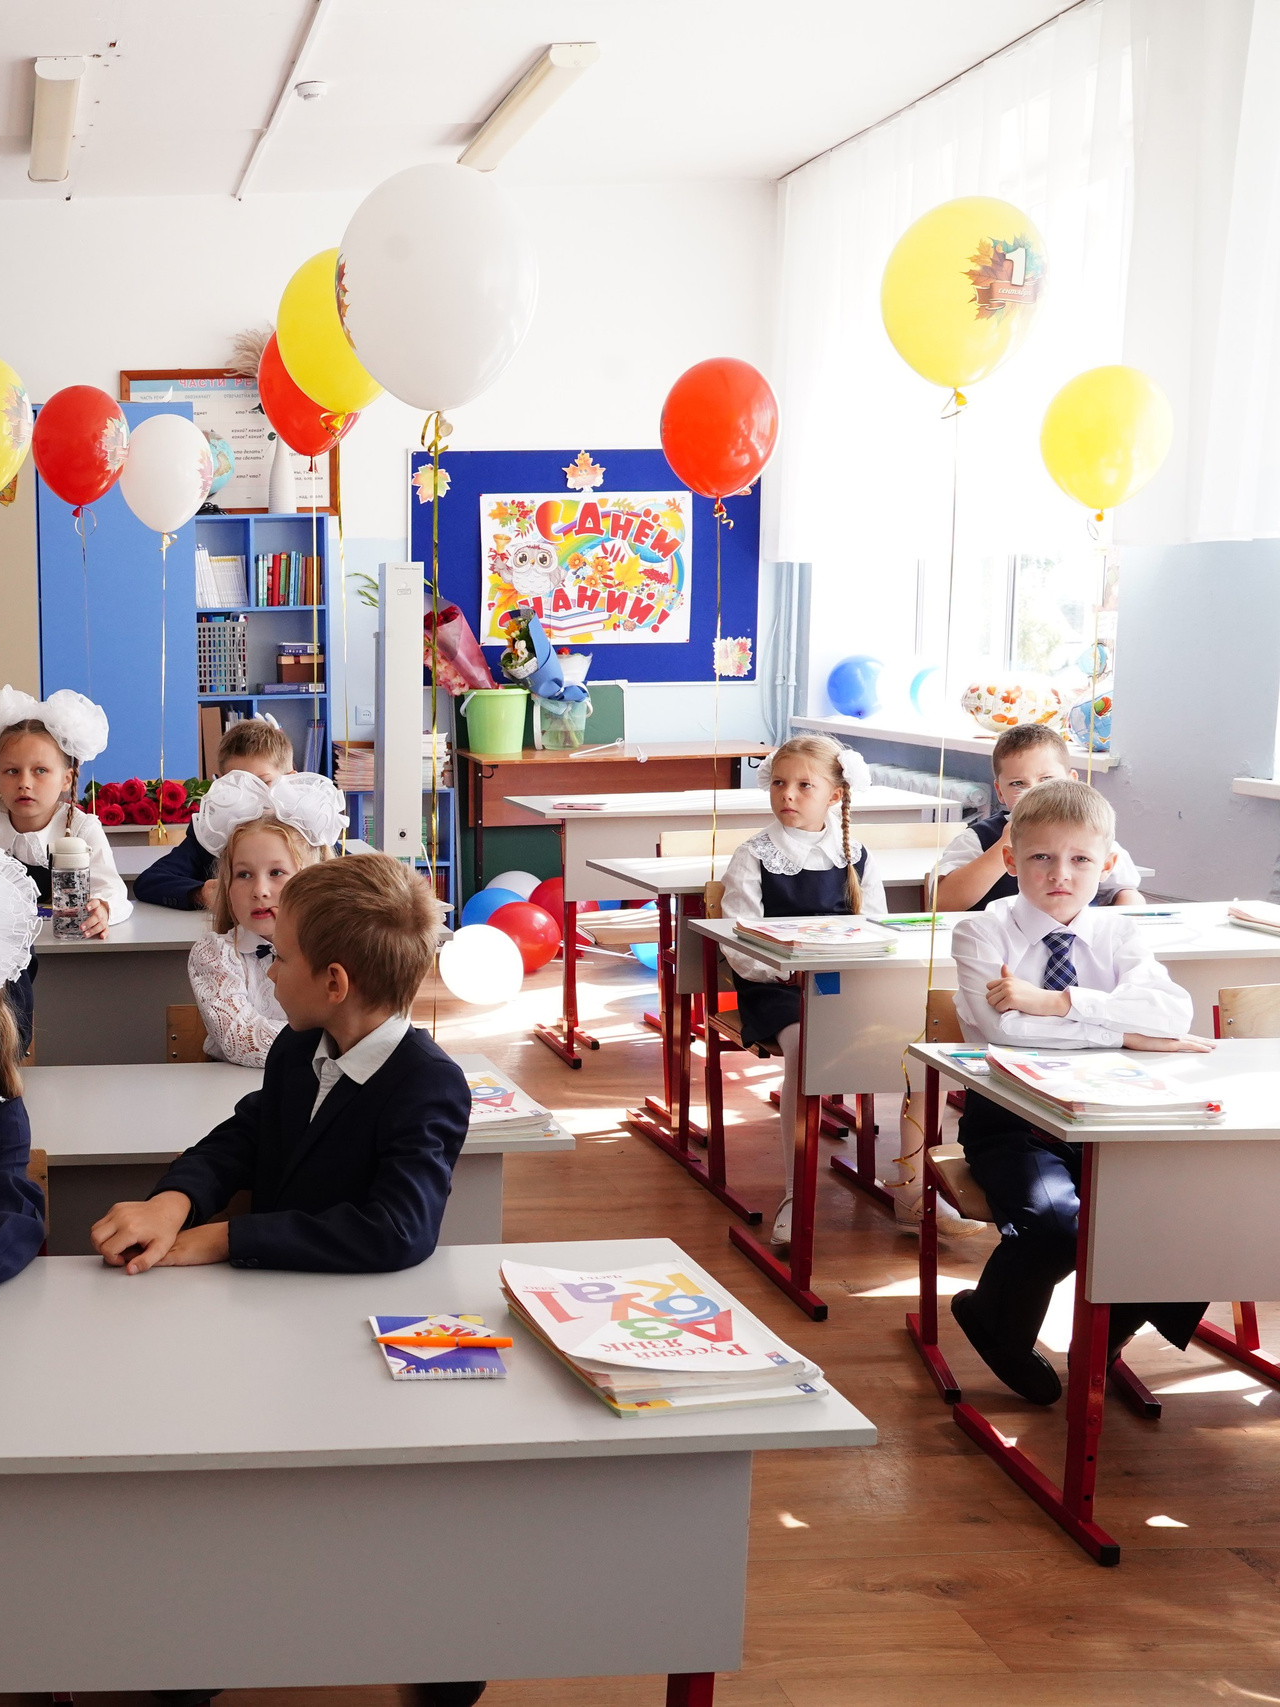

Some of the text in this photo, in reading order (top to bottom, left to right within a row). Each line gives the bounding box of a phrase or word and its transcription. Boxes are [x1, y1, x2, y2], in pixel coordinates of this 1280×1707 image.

[1005, 247, 1026, 286] 1
[179, 377, 258, 388] ЧАСТИ РЕ
[535, 500, 682, 560] С ДНЁМ
[522, 1290, 584, 1324] 1
[633, 1343, 752, 1360] Русский
